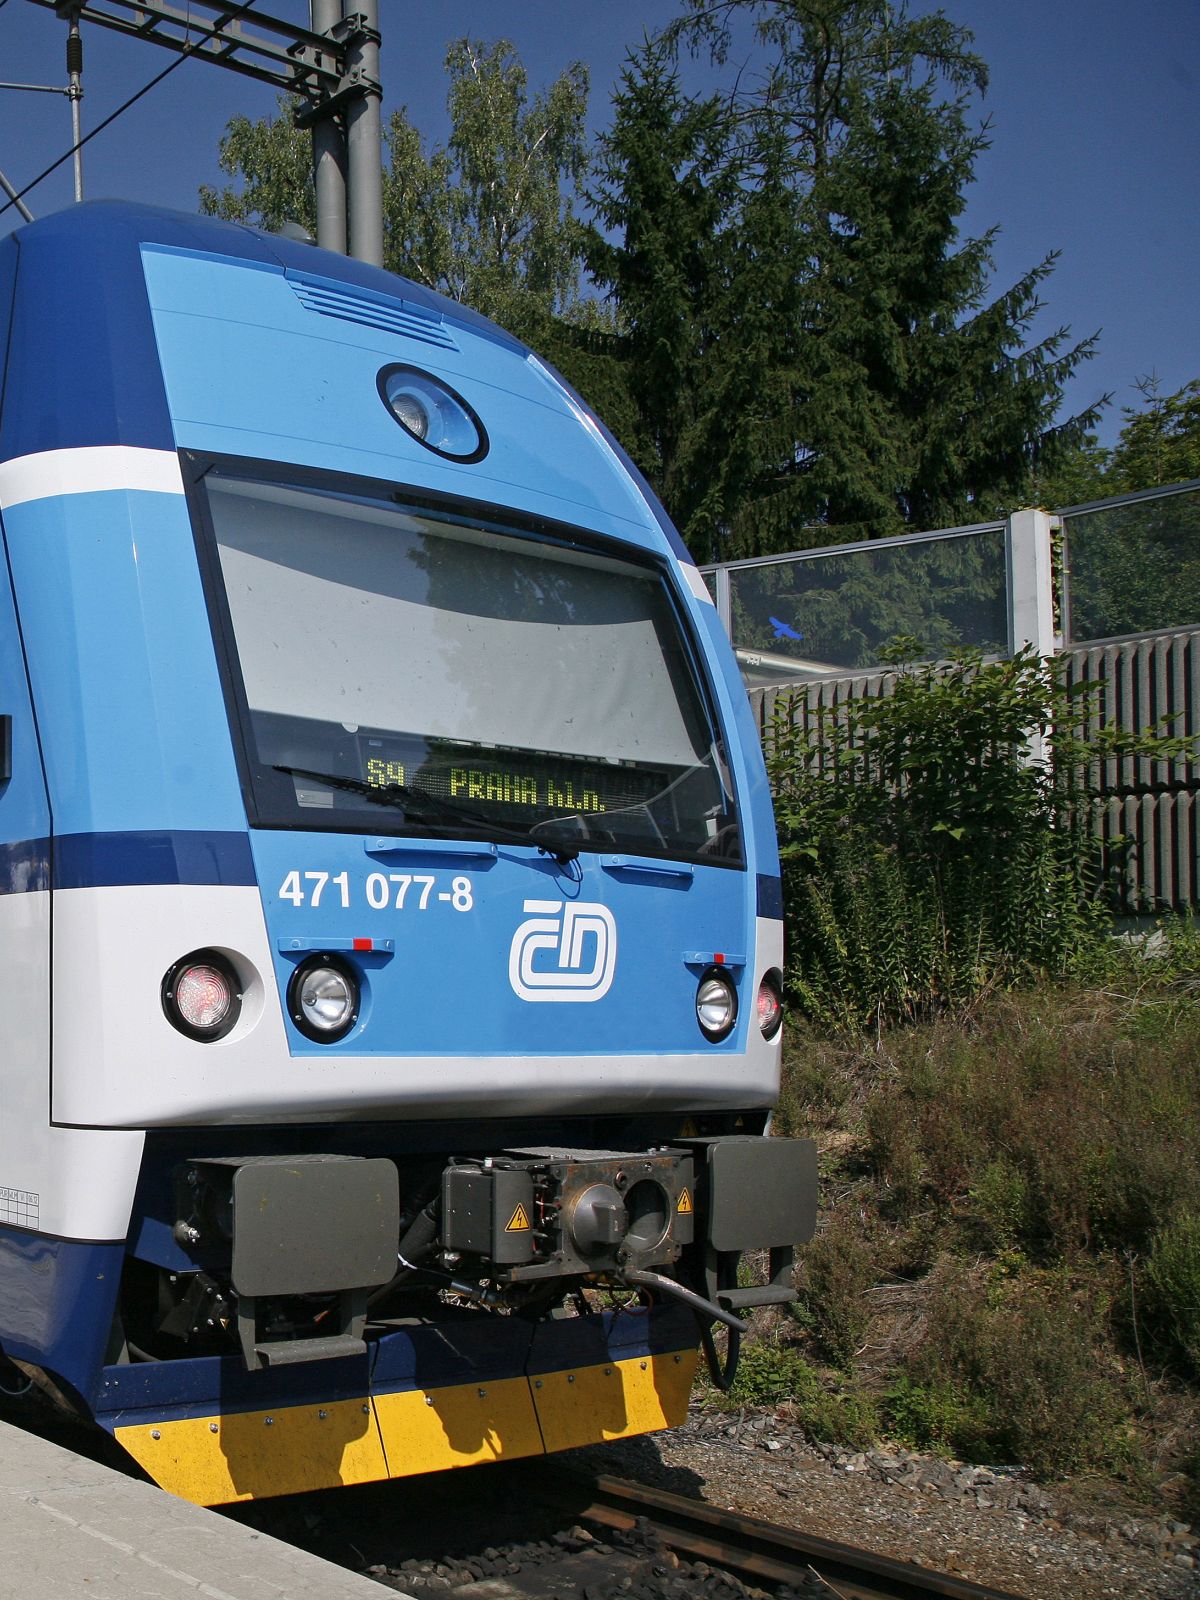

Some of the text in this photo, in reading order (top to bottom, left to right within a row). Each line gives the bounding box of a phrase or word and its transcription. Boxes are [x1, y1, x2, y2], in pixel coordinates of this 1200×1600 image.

[450, 768, 537, 805] PRAHA
[278, 870, 474, 912] 471 077-8
[508, 899, 617, 1002] ČD
